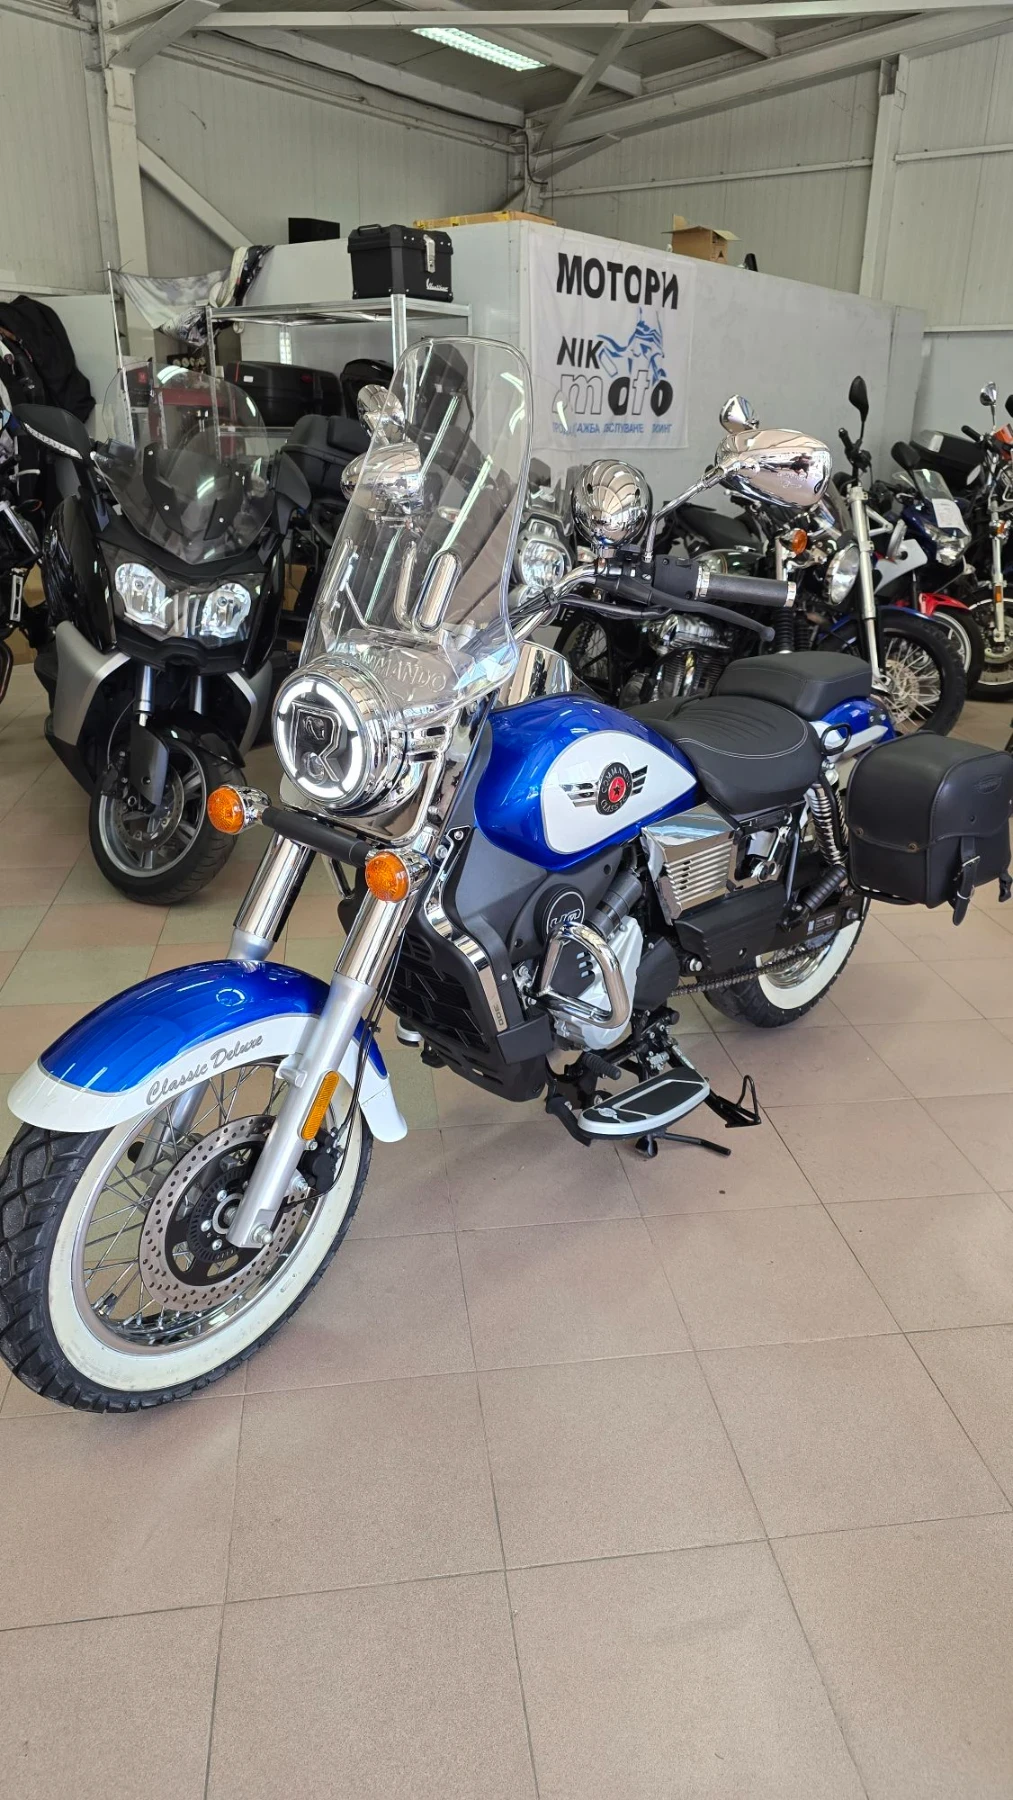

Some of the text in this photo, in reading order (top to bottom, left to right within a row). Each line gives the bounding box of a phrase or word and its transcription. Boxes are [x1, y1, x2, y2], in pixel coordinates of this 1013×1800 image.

[556, 252, 679, 310] МОТОРИ
[556, 335, 604, 370] NIK
[145, 1035, 264, 1105] Classic Deluxe
